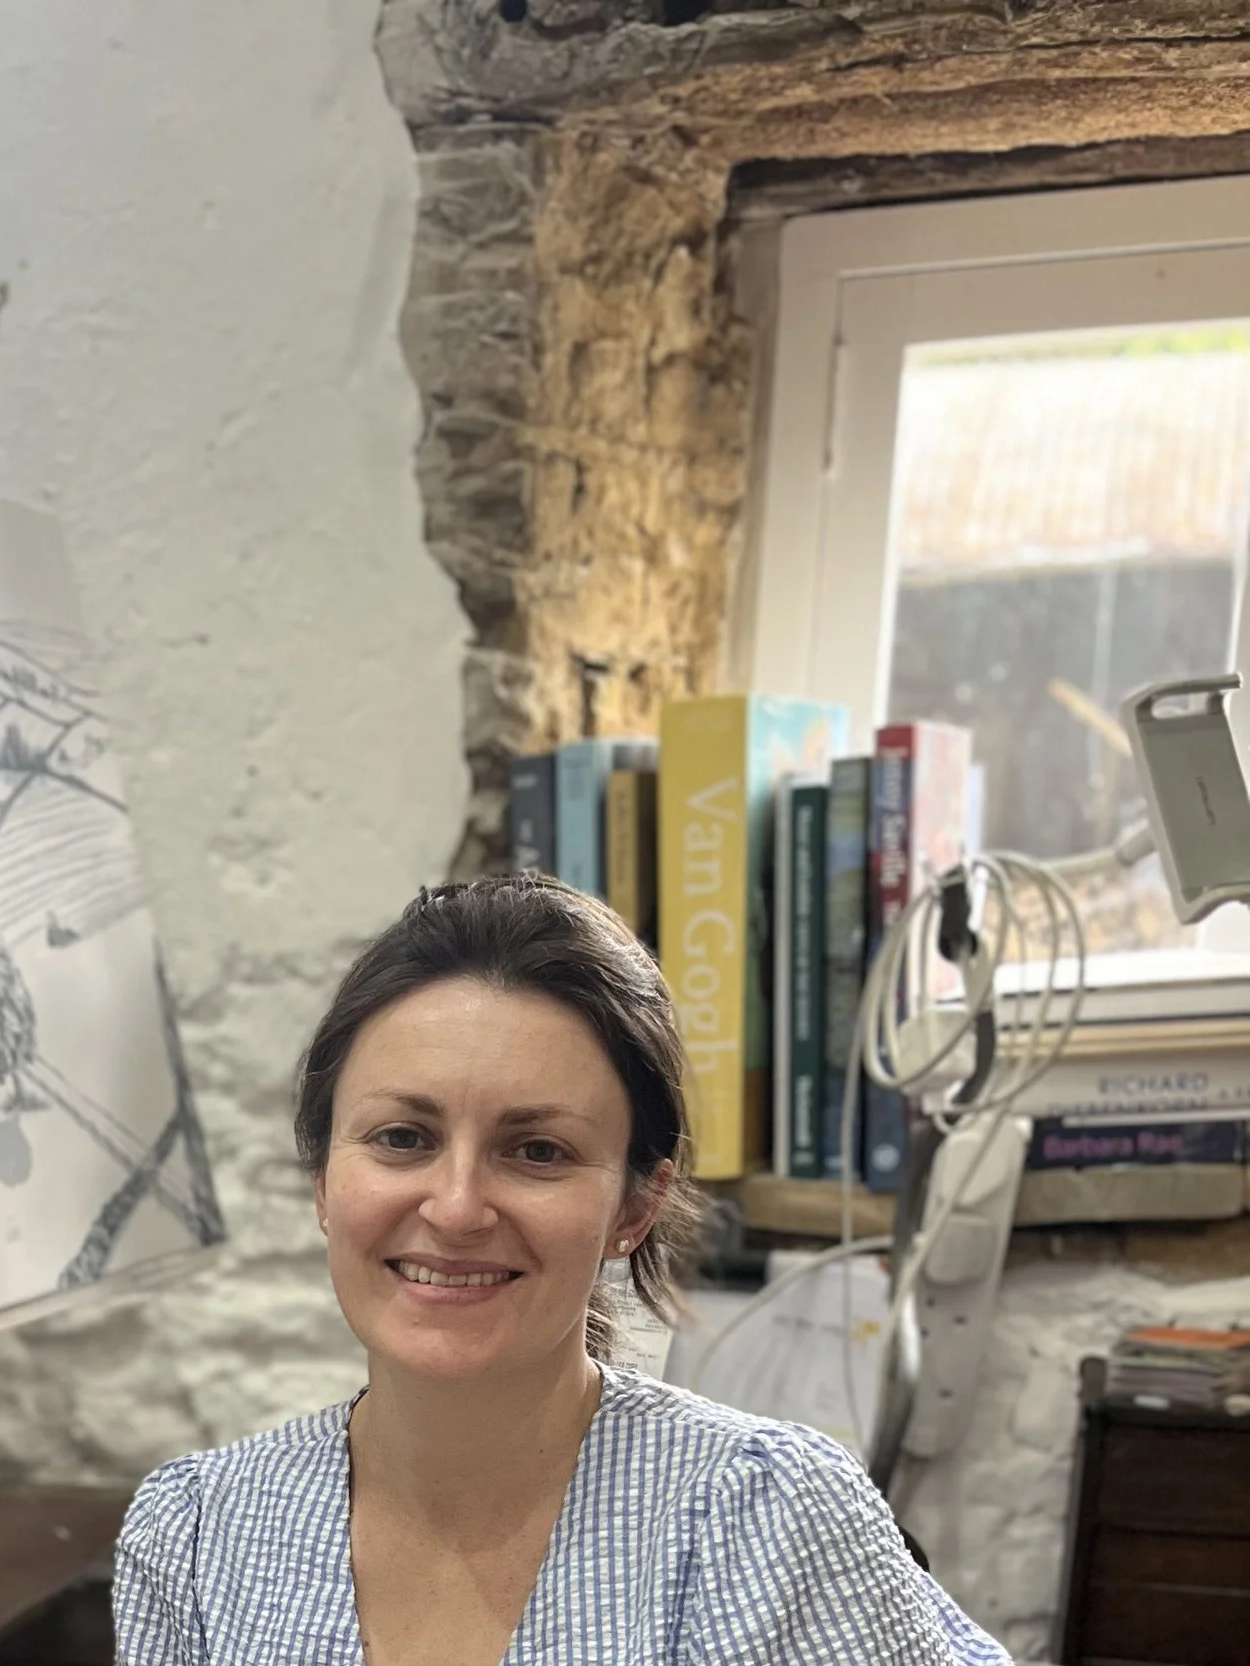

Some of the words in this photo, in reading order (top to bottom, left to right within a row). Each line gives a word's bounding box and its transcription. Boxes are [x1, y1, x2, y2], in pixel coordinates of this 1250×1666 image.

[682, 775, 738, 897] Van
[880, 813, 907, 888] Saville
[679, 910, 738, 1076] Gogh
[1097, 1072, 1209, 1097] RICHARD
